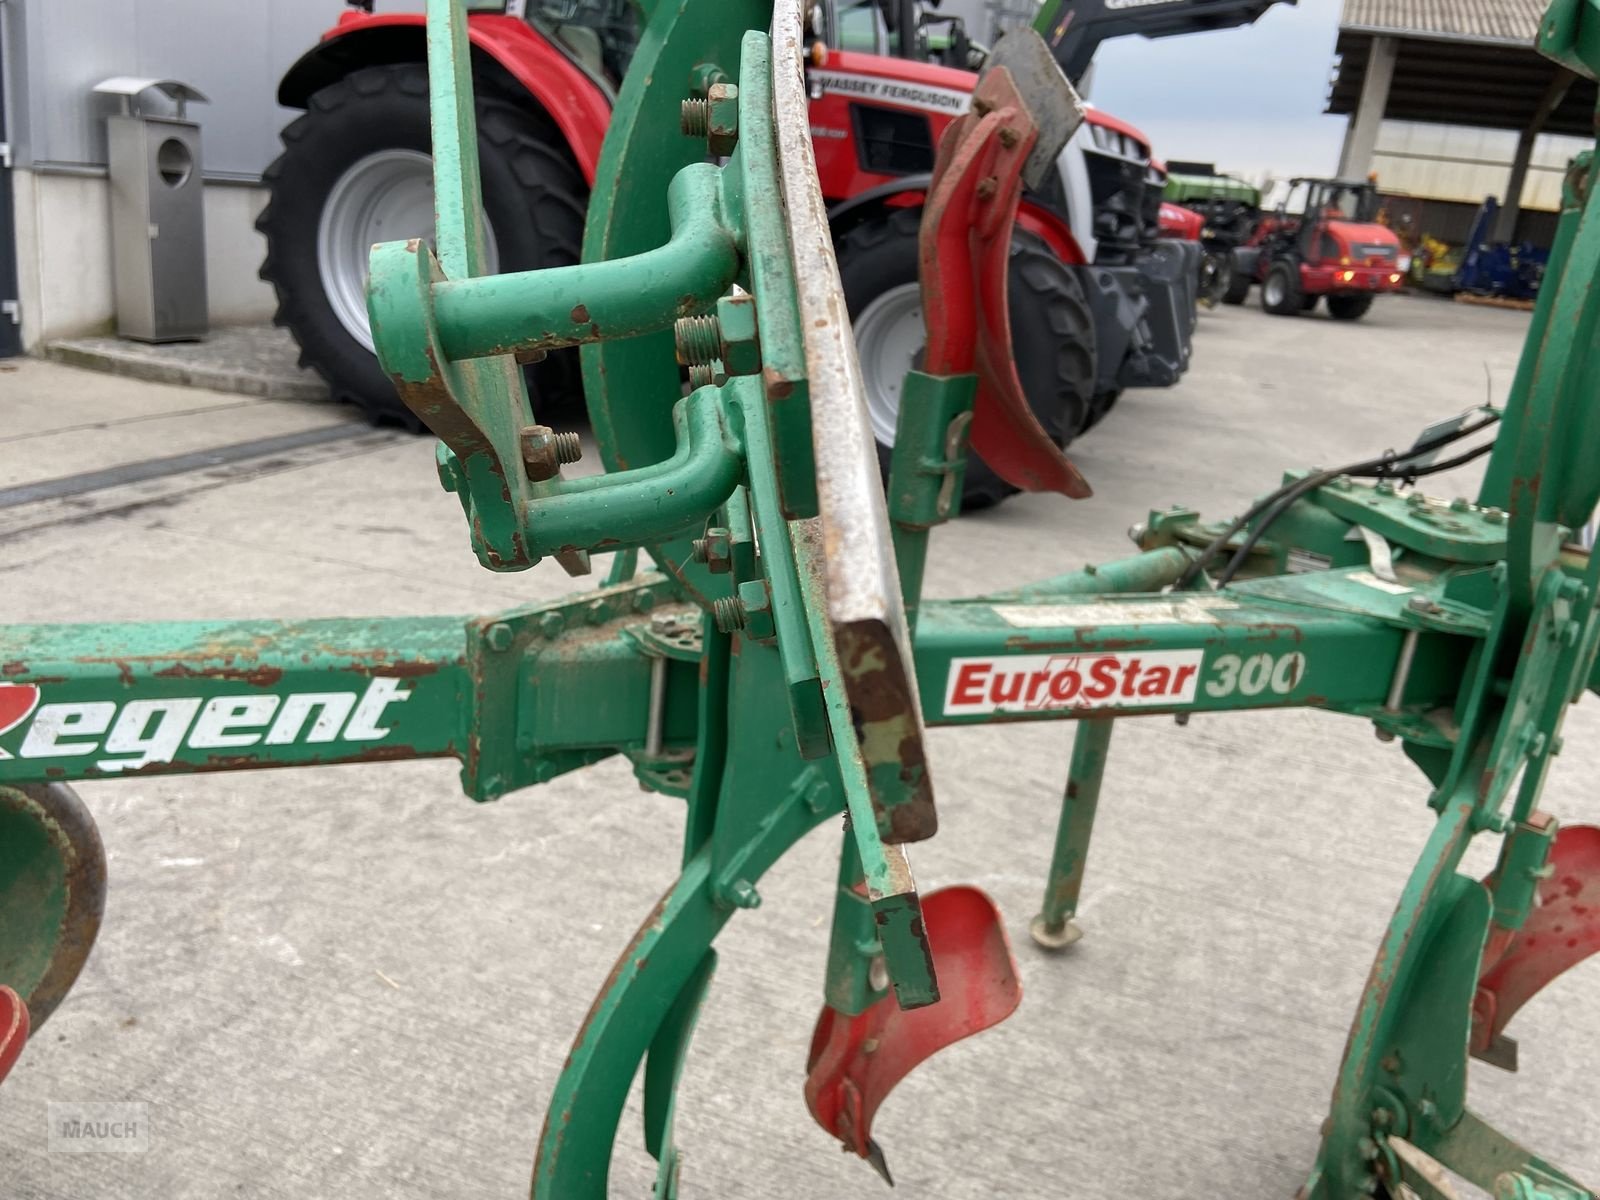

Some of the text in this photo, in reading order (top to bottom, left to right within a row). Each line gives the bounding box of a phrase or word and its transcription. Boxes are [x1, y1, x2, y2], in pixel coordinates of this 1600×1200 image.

[819, 76, 963, 109] MASSEY FERGUSON
[950, 651, 1306, 706] EuroStar 300
